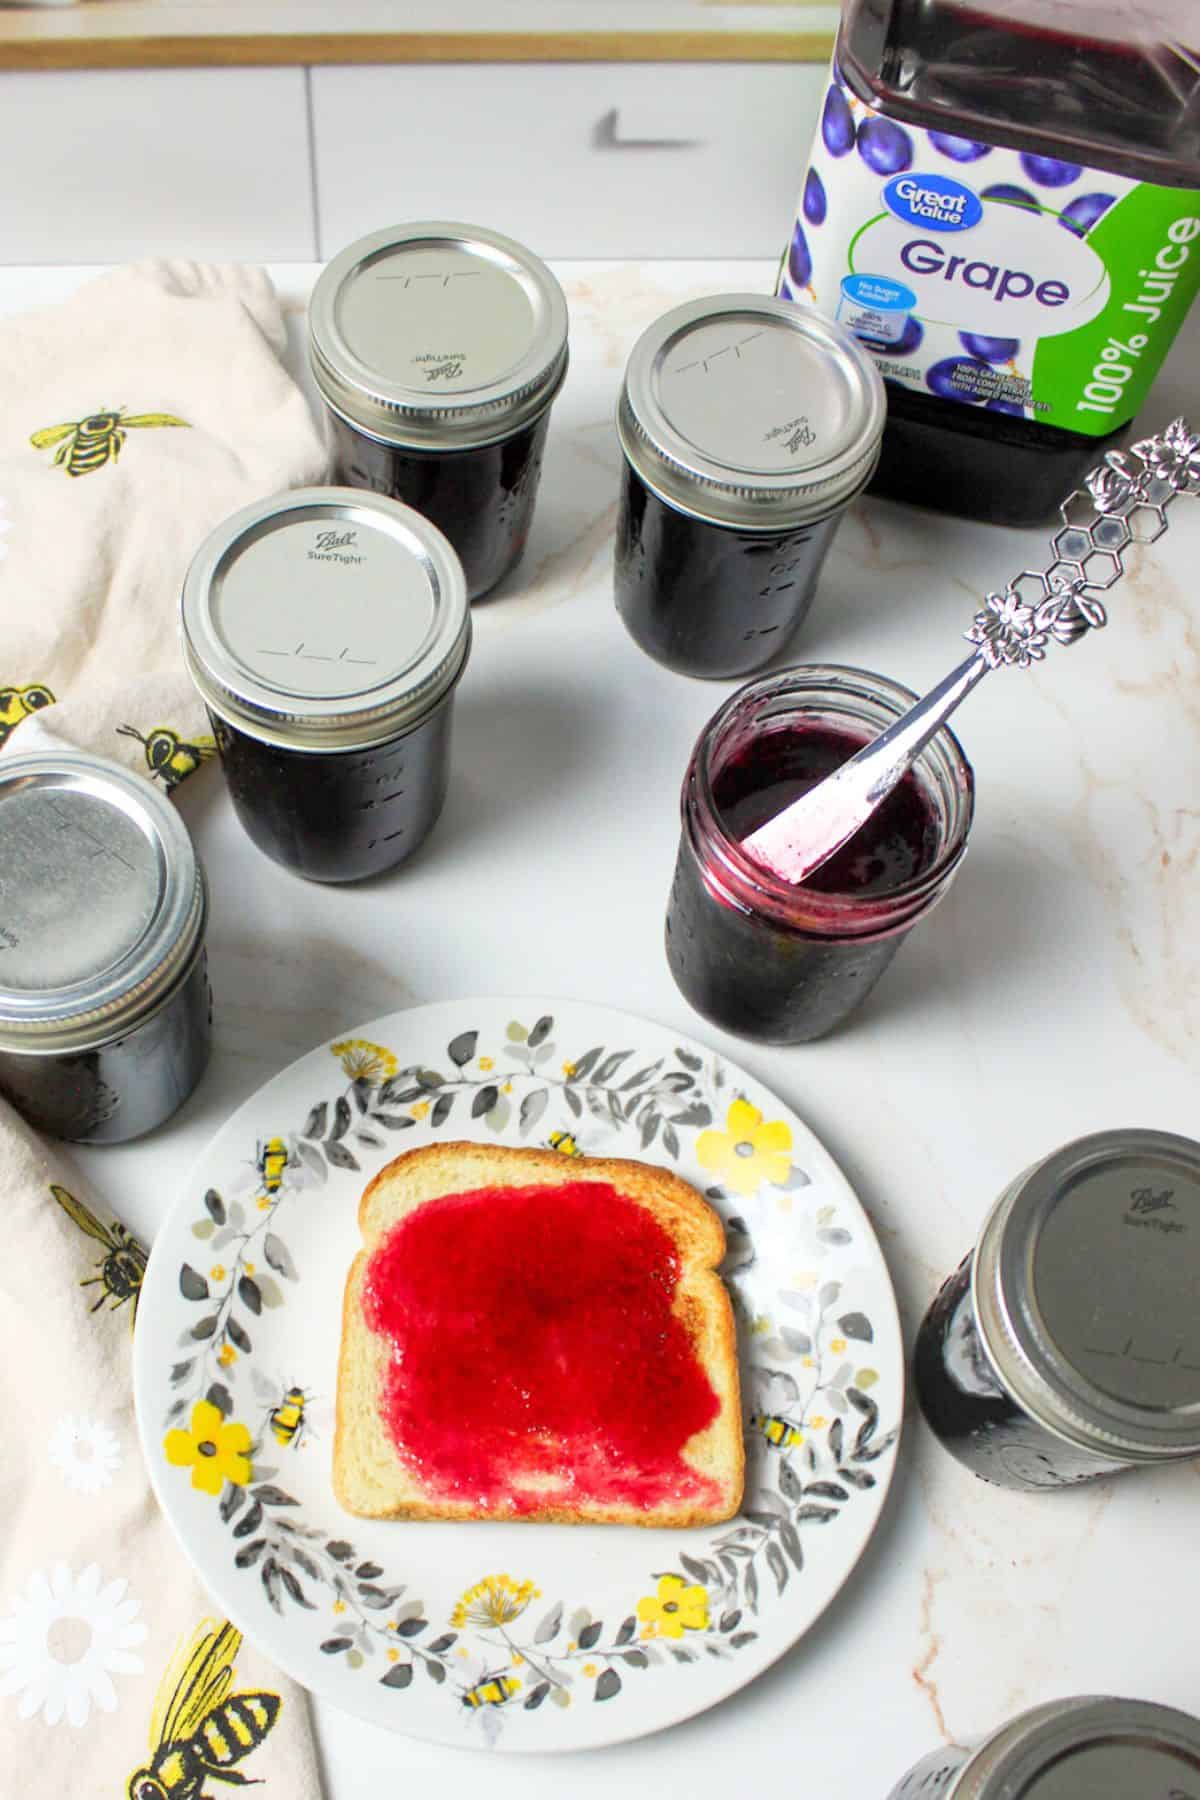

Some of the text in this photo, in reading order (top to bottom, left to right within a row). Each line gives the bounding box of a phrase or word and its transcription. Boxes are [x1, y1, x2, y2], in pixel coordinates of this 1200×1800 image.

[896, 180, 967, 212] Great
[910, 200, 962, 224] Value
[900, 239, 1070, 307] Grape
[1076, 217, 1200, 413] 100% Juice
[424, 362, 463, 382] Ball
[316, 531, 358, 552] Ball
[307, 551, 362, 565] SureTight
